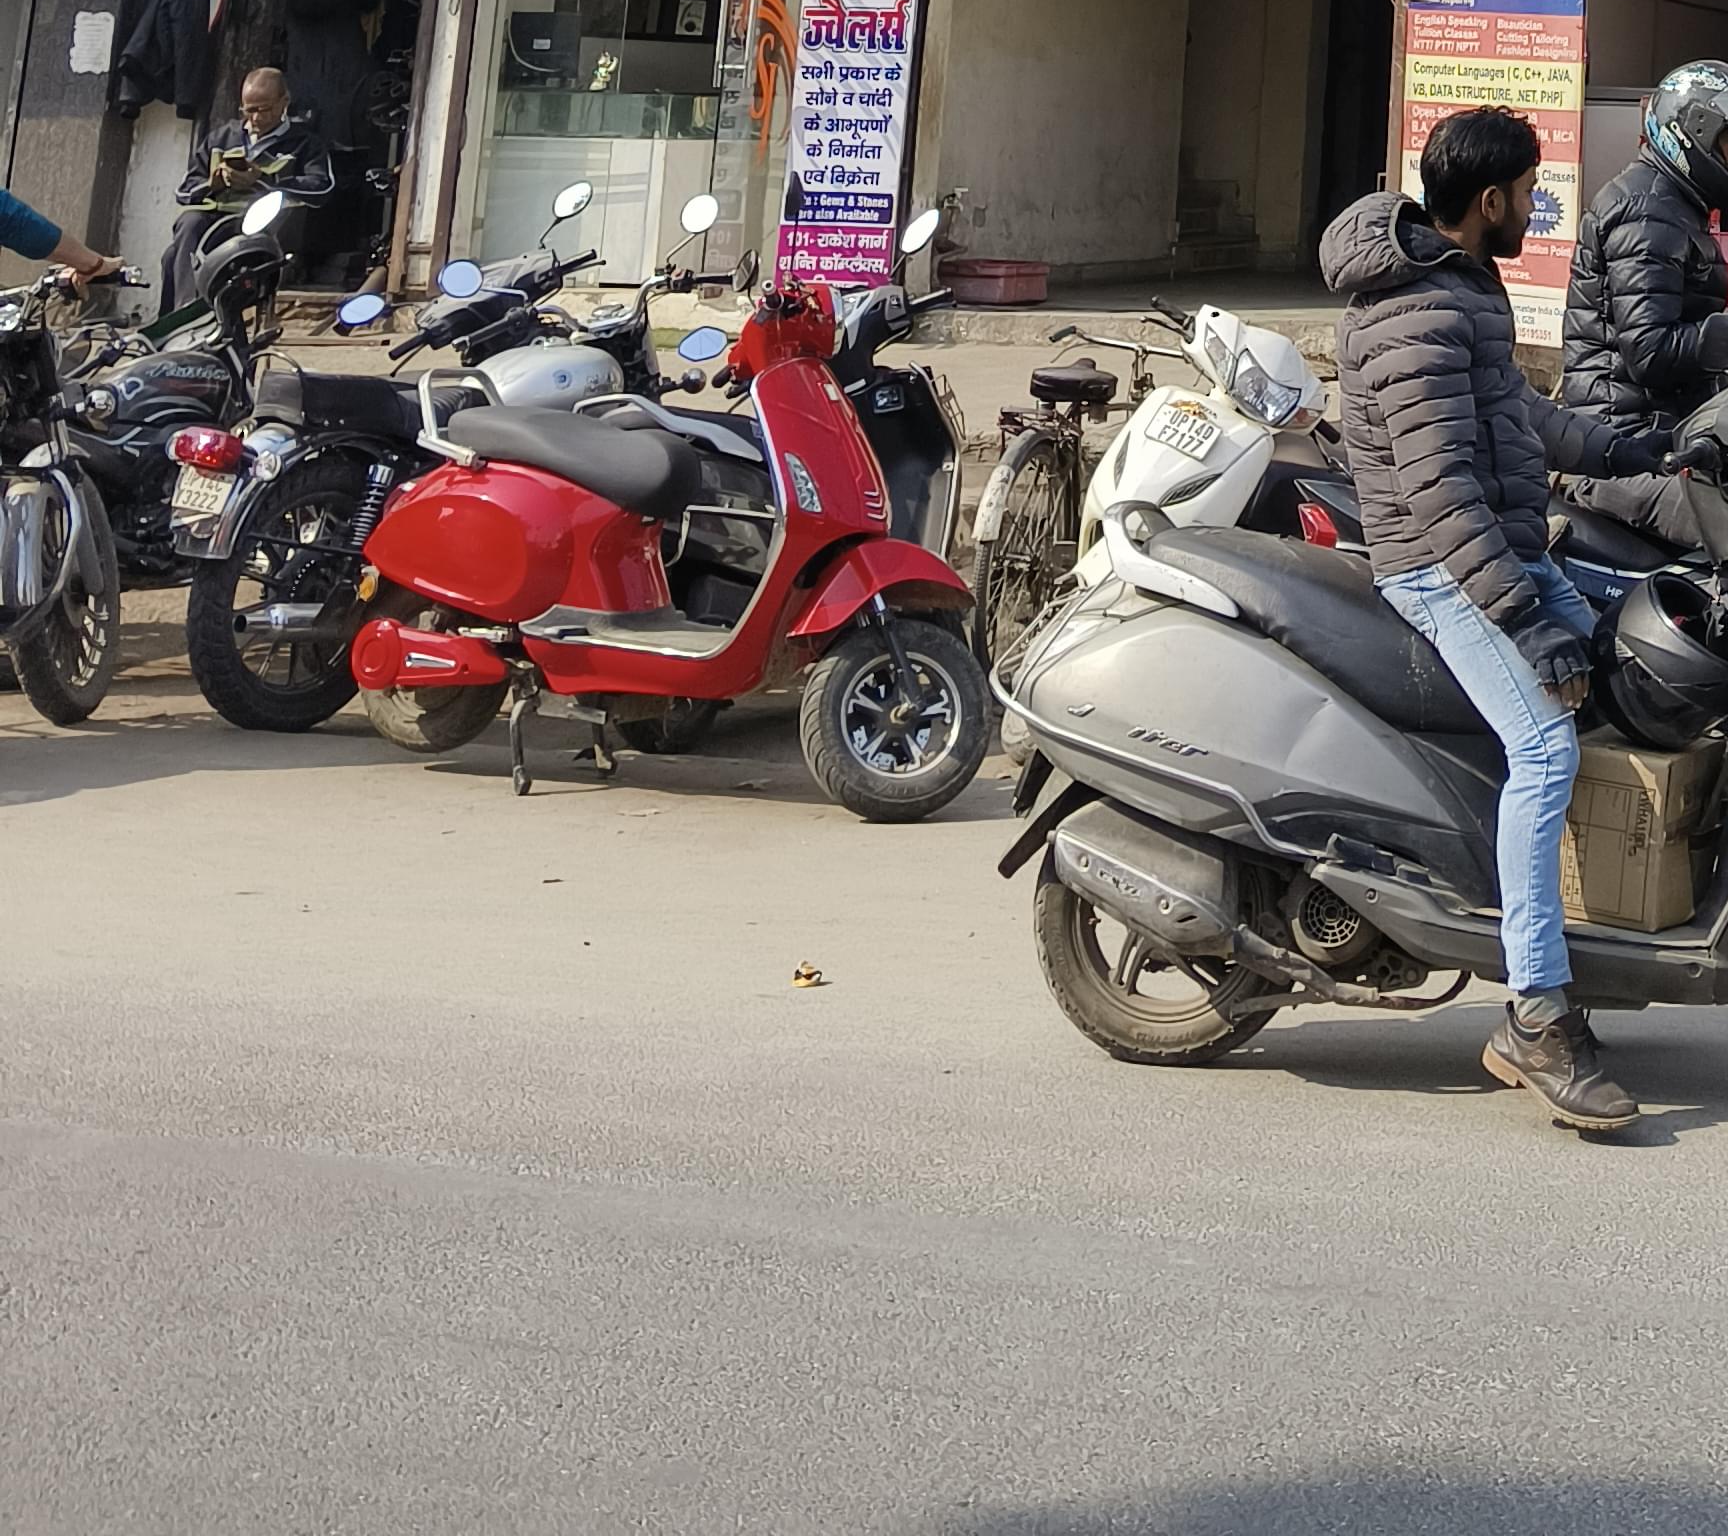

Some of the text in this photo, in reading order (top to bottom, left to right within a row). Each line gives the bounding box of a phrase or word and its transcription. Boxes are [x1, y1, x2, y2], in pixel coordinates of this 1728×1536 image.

[802, 61, 902, 82] सभी प्रकार के
[1414, 62, 1505, 81] Computer Languages
[806, 87, 893, 107] सोने व चांदी
[807, 139, 882, 159] के निर्माता
[804, 165, 880, 187] एवं विक्रेता
[1170, 409, 1214, 440] UP14D
[1158, 425, 1204, 453] F7177
